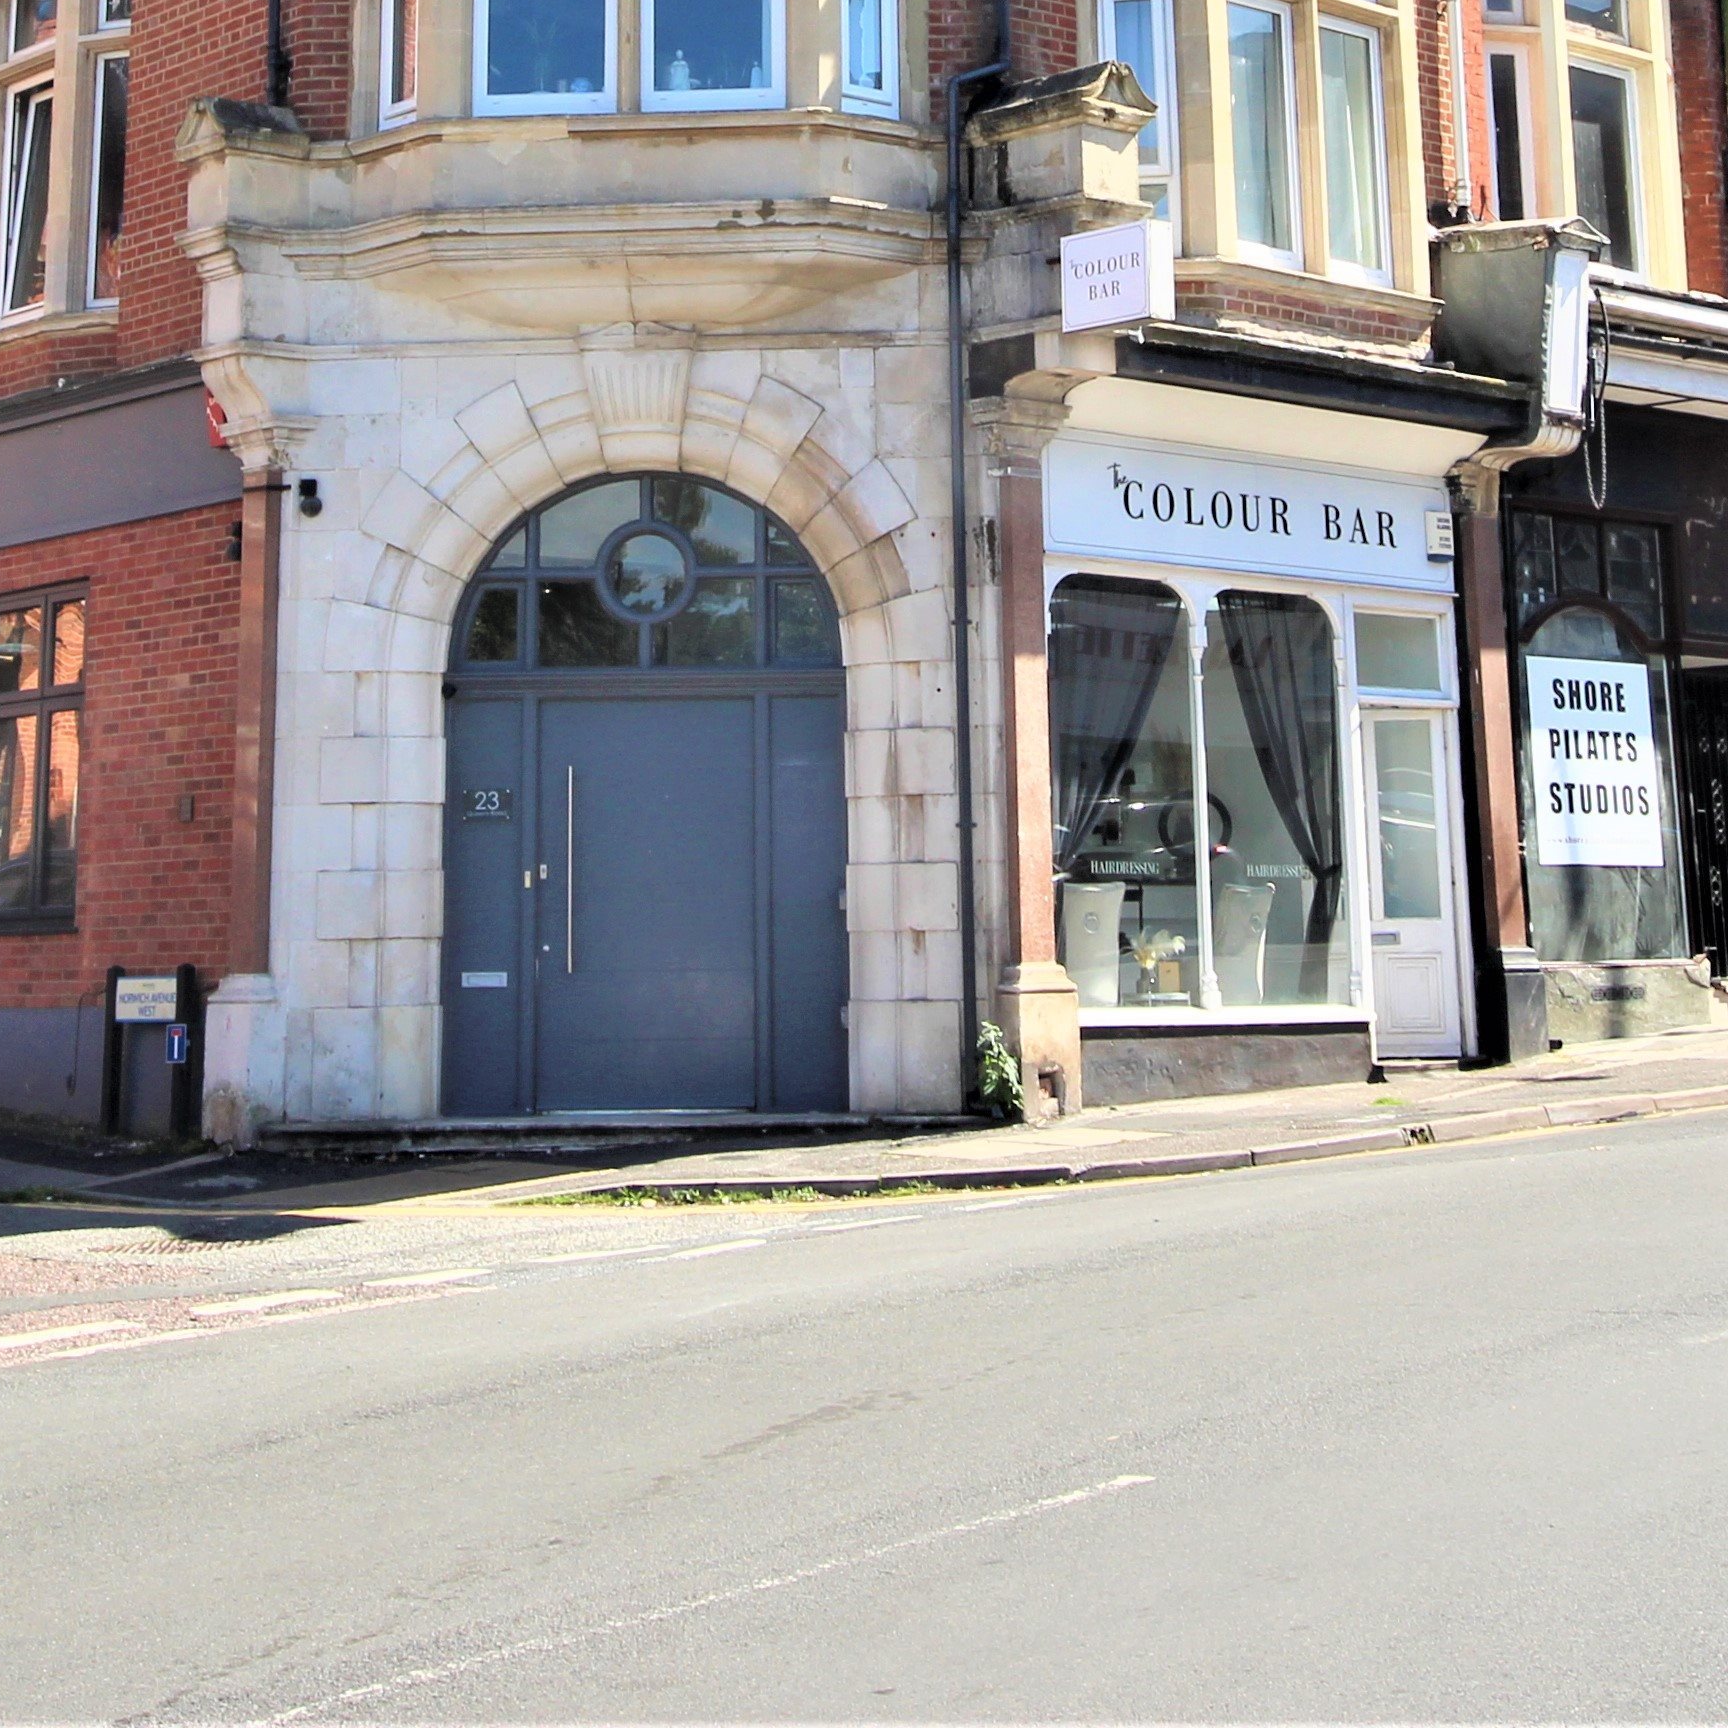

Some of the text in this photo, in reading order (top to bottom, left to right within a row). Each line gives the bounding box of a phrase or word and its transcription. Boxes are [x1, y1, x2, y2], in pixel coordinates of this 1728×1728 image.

[1074, 252, 1140, 280] COLOUR
[1089, 280, 1121, 300] BAR
[1123, 480, 1291, 536] COLOUR
[1323, 504, 1397, 549] BAR
[1552, 678, 1626, 713] SHORE
[1548, 728, 1638, 762] PILATES
[475, 791, 499, 811] 23
[1549, 781, 1649, 816] STUDIOS
[1090, 860, 1160, 875] HAIRDRESSING
[138, 1005, 156, 1017] WEST
